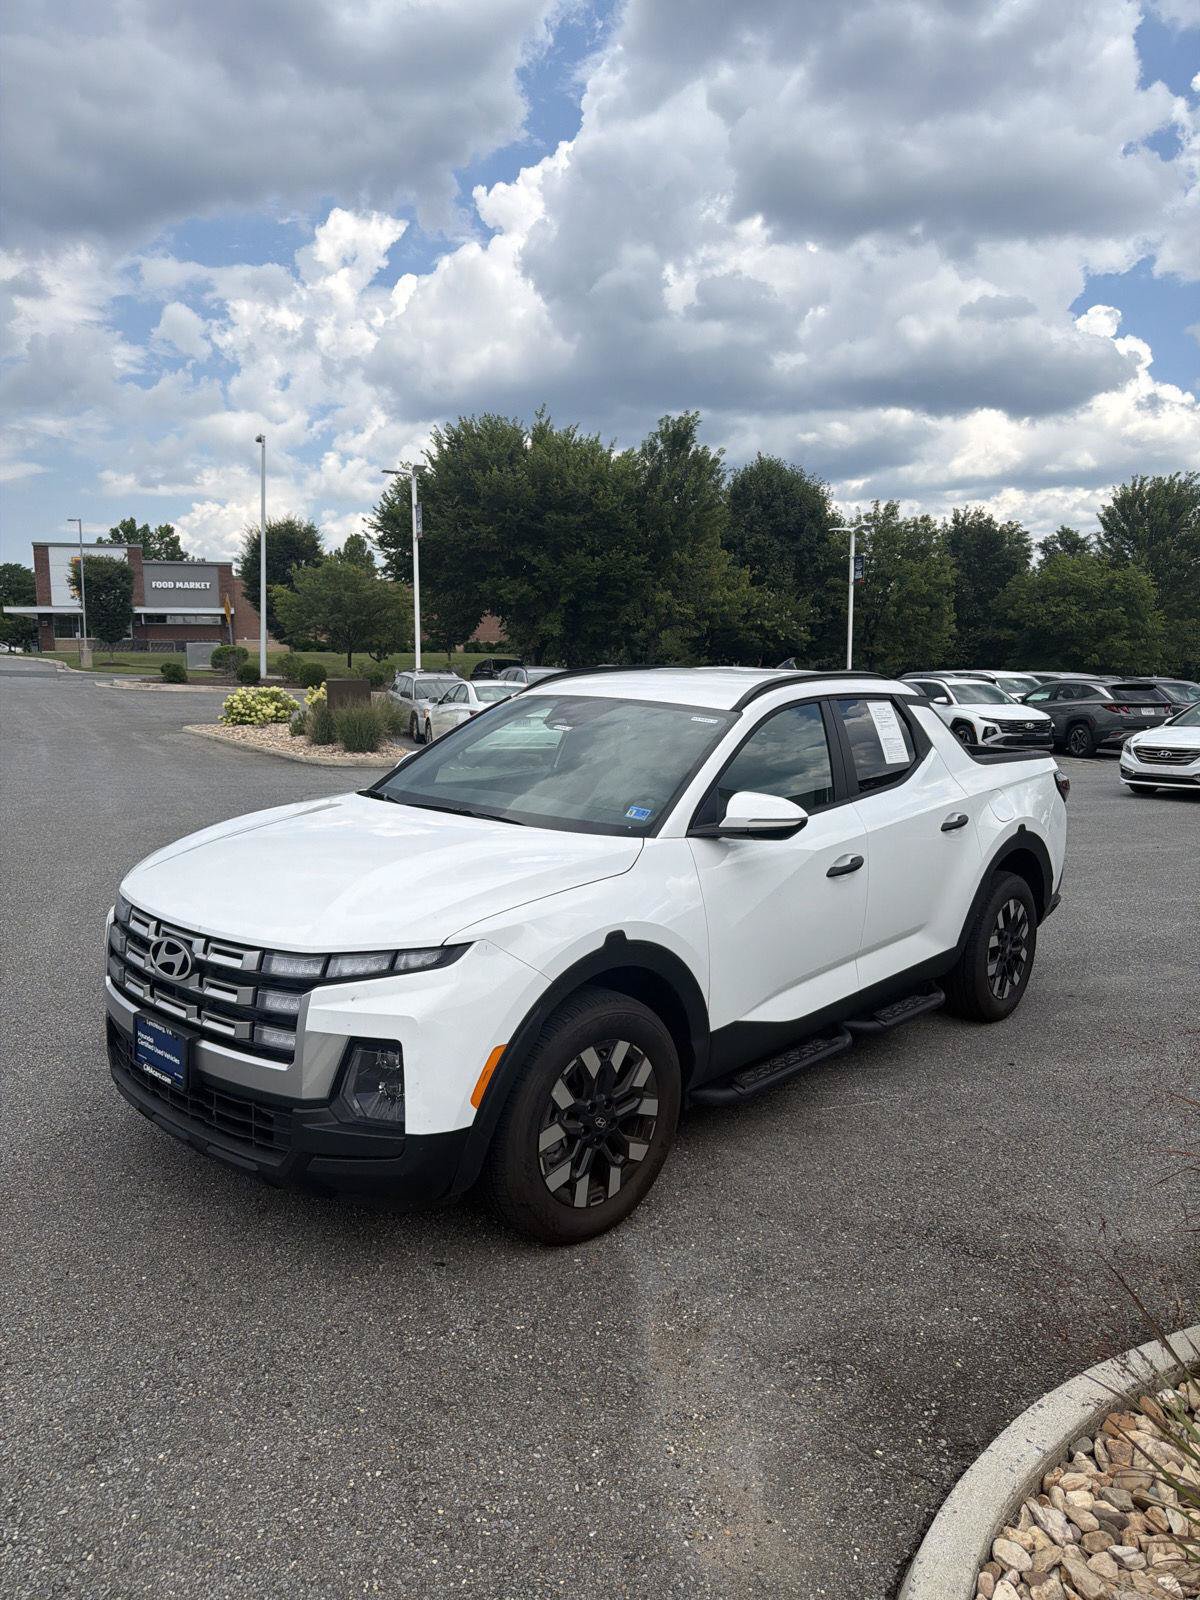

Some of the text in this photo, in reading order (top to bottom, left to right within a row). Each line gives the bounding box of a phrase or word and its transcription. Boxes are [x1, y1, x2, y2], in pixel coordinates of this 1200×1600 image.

[152, 581, 211, 589] FOOD MARKET
[164, 1051, 180, 1065] Vehicles
